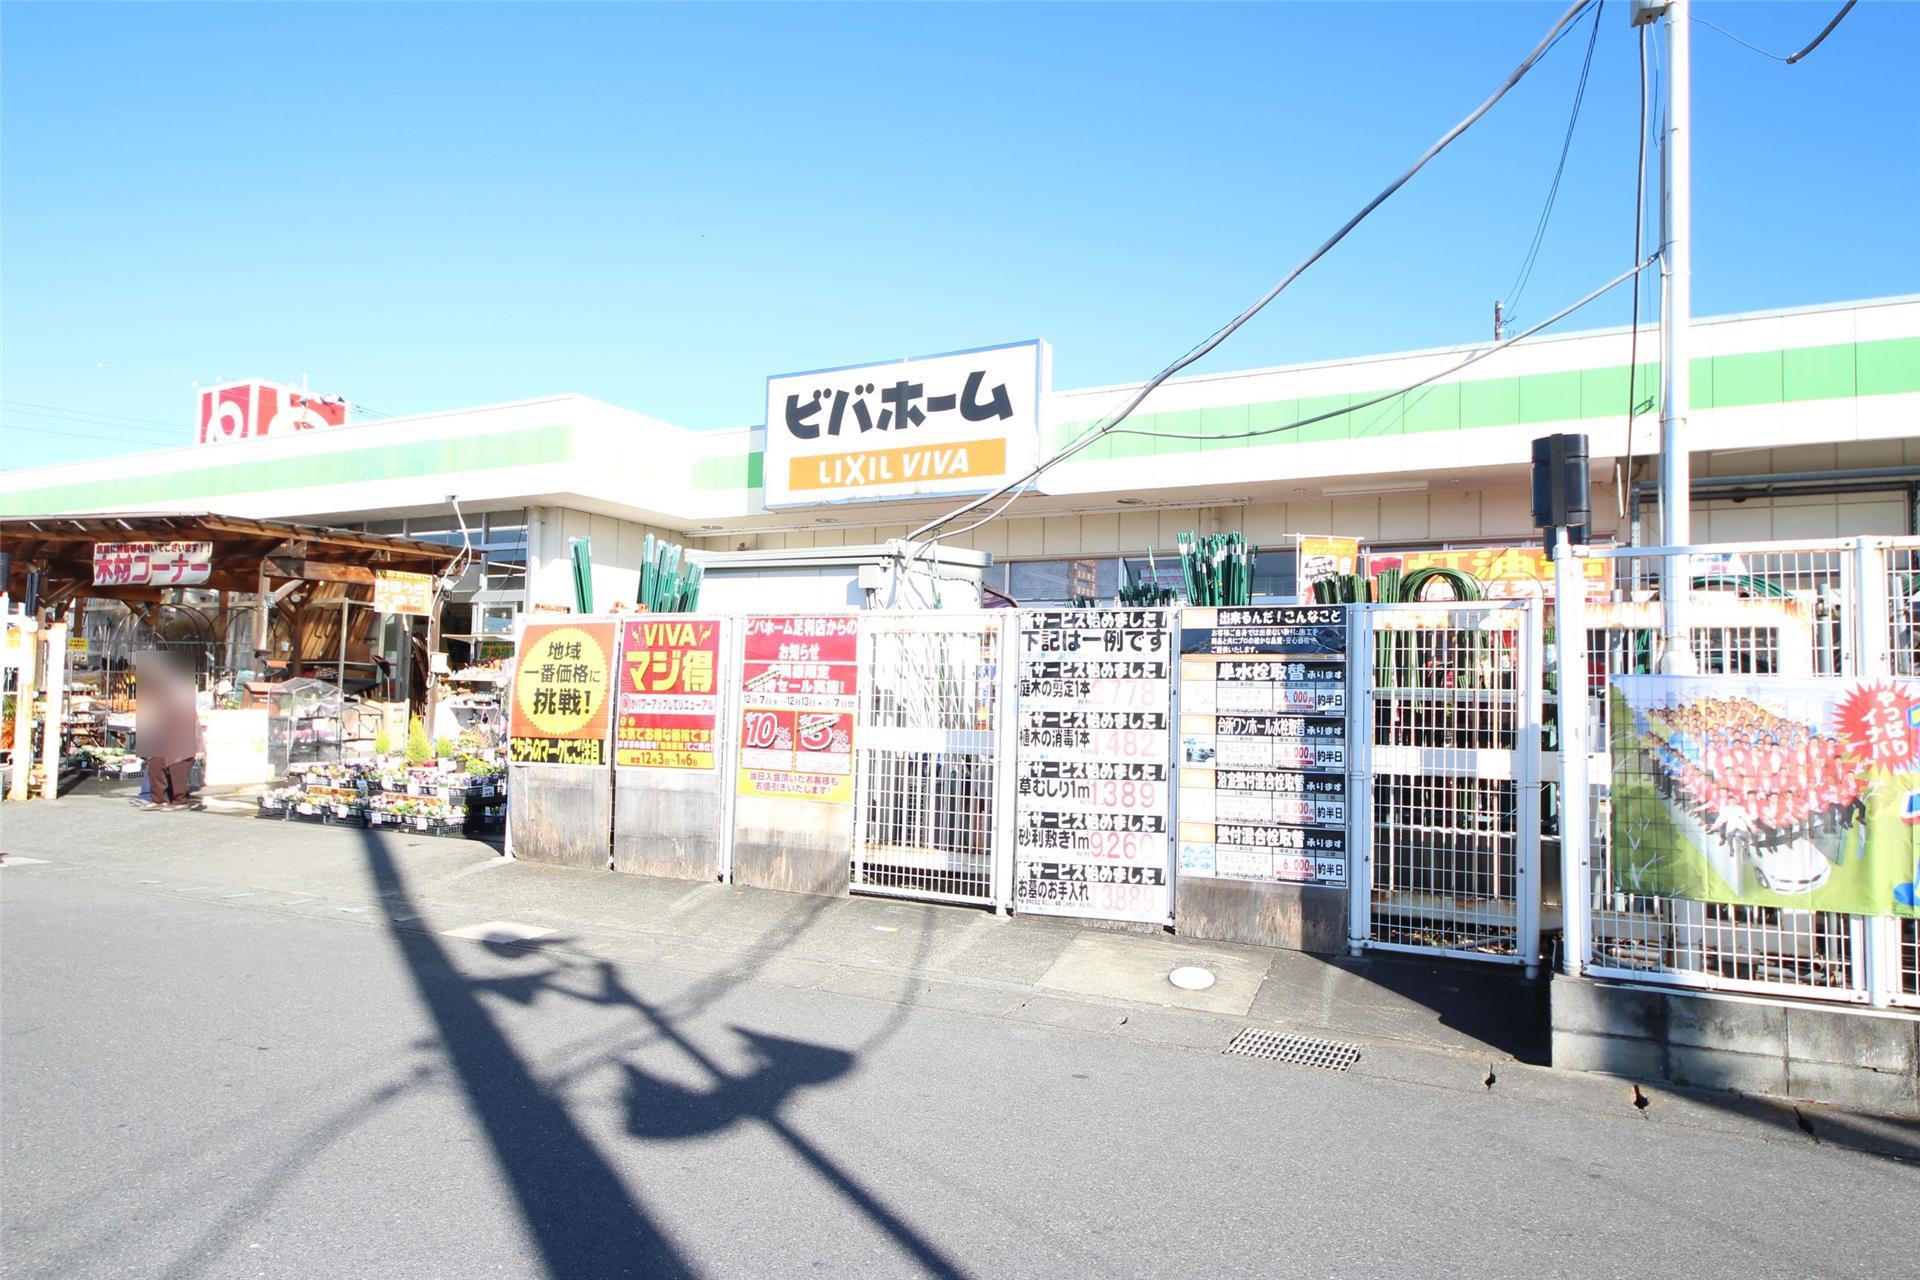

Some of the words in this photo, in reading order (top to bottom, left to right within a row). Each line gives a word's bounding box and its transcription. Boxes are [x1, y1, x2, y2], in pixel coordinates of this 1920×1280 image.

[785, 370, 1013, 439] ビバホーム
[819, 454, 893, 485] LIXIL
[902, 448, 969, 478] VIVA
[95, 553, 209, 584] 木材コーナー
[1408, 549, 1606, 578] 灯油
[643, 623, 697, 647] VIVA
[1021, 629, 1167, 652] 下記は一例です
[547, 641, 582, 660] 地域
[778, 643, 820, 661] お知らせ
[524, 664, 601, 684] 一番価格に
[626, 649, 713, 692] マジ得
[1218, 663, 1306, 681] 単水栓取替
[1307, 670, 1343, 679] 承ります
[1020, 680, 1090, 698] 庭木の剪定1本
[533, 688, 591, 716] 挑戦!
[1317, 694, 1343, 706] 約半日
[1019, 729, 1090, 748] 植木の消毒1本
[1306, 726, 1342, 735] 承ります
[1317, 751, 1342, 762] 約半日
[1306, 782, 1342, 792] 承ります
[1317, 807, 1342, 819] 約半日
[1306, 838, 1342, 849] 承ります
[1317, 863, 1343, 876] 約半日
[1018, 880, 1089, 901] お墓のお手入れ
